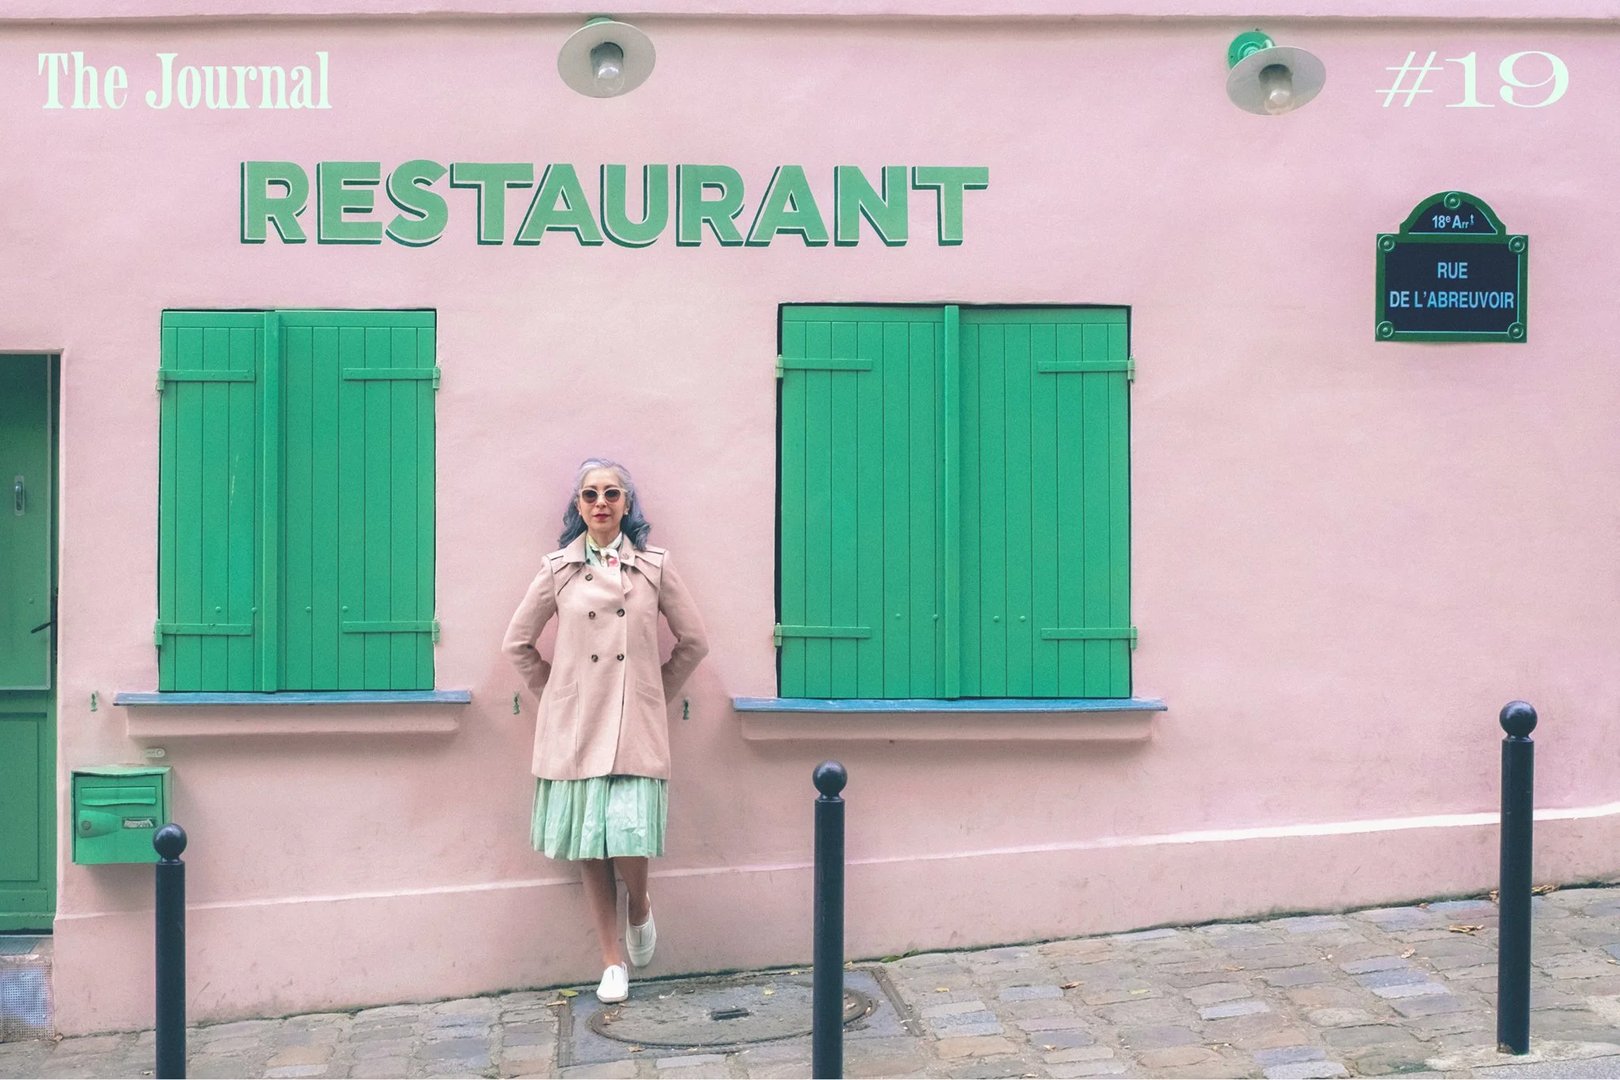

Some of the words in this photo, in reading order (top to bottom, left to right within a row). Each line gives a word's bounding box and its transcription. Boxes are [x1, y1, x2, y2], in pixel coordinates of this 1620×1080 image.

[240, 159, 989, 247] RESTAURANT
[1437, 262, 1469, 279] RUE
[1389, 291, 1410, 308] DE
[1414, 291, 1515, 309] L'ABREUVOIR
